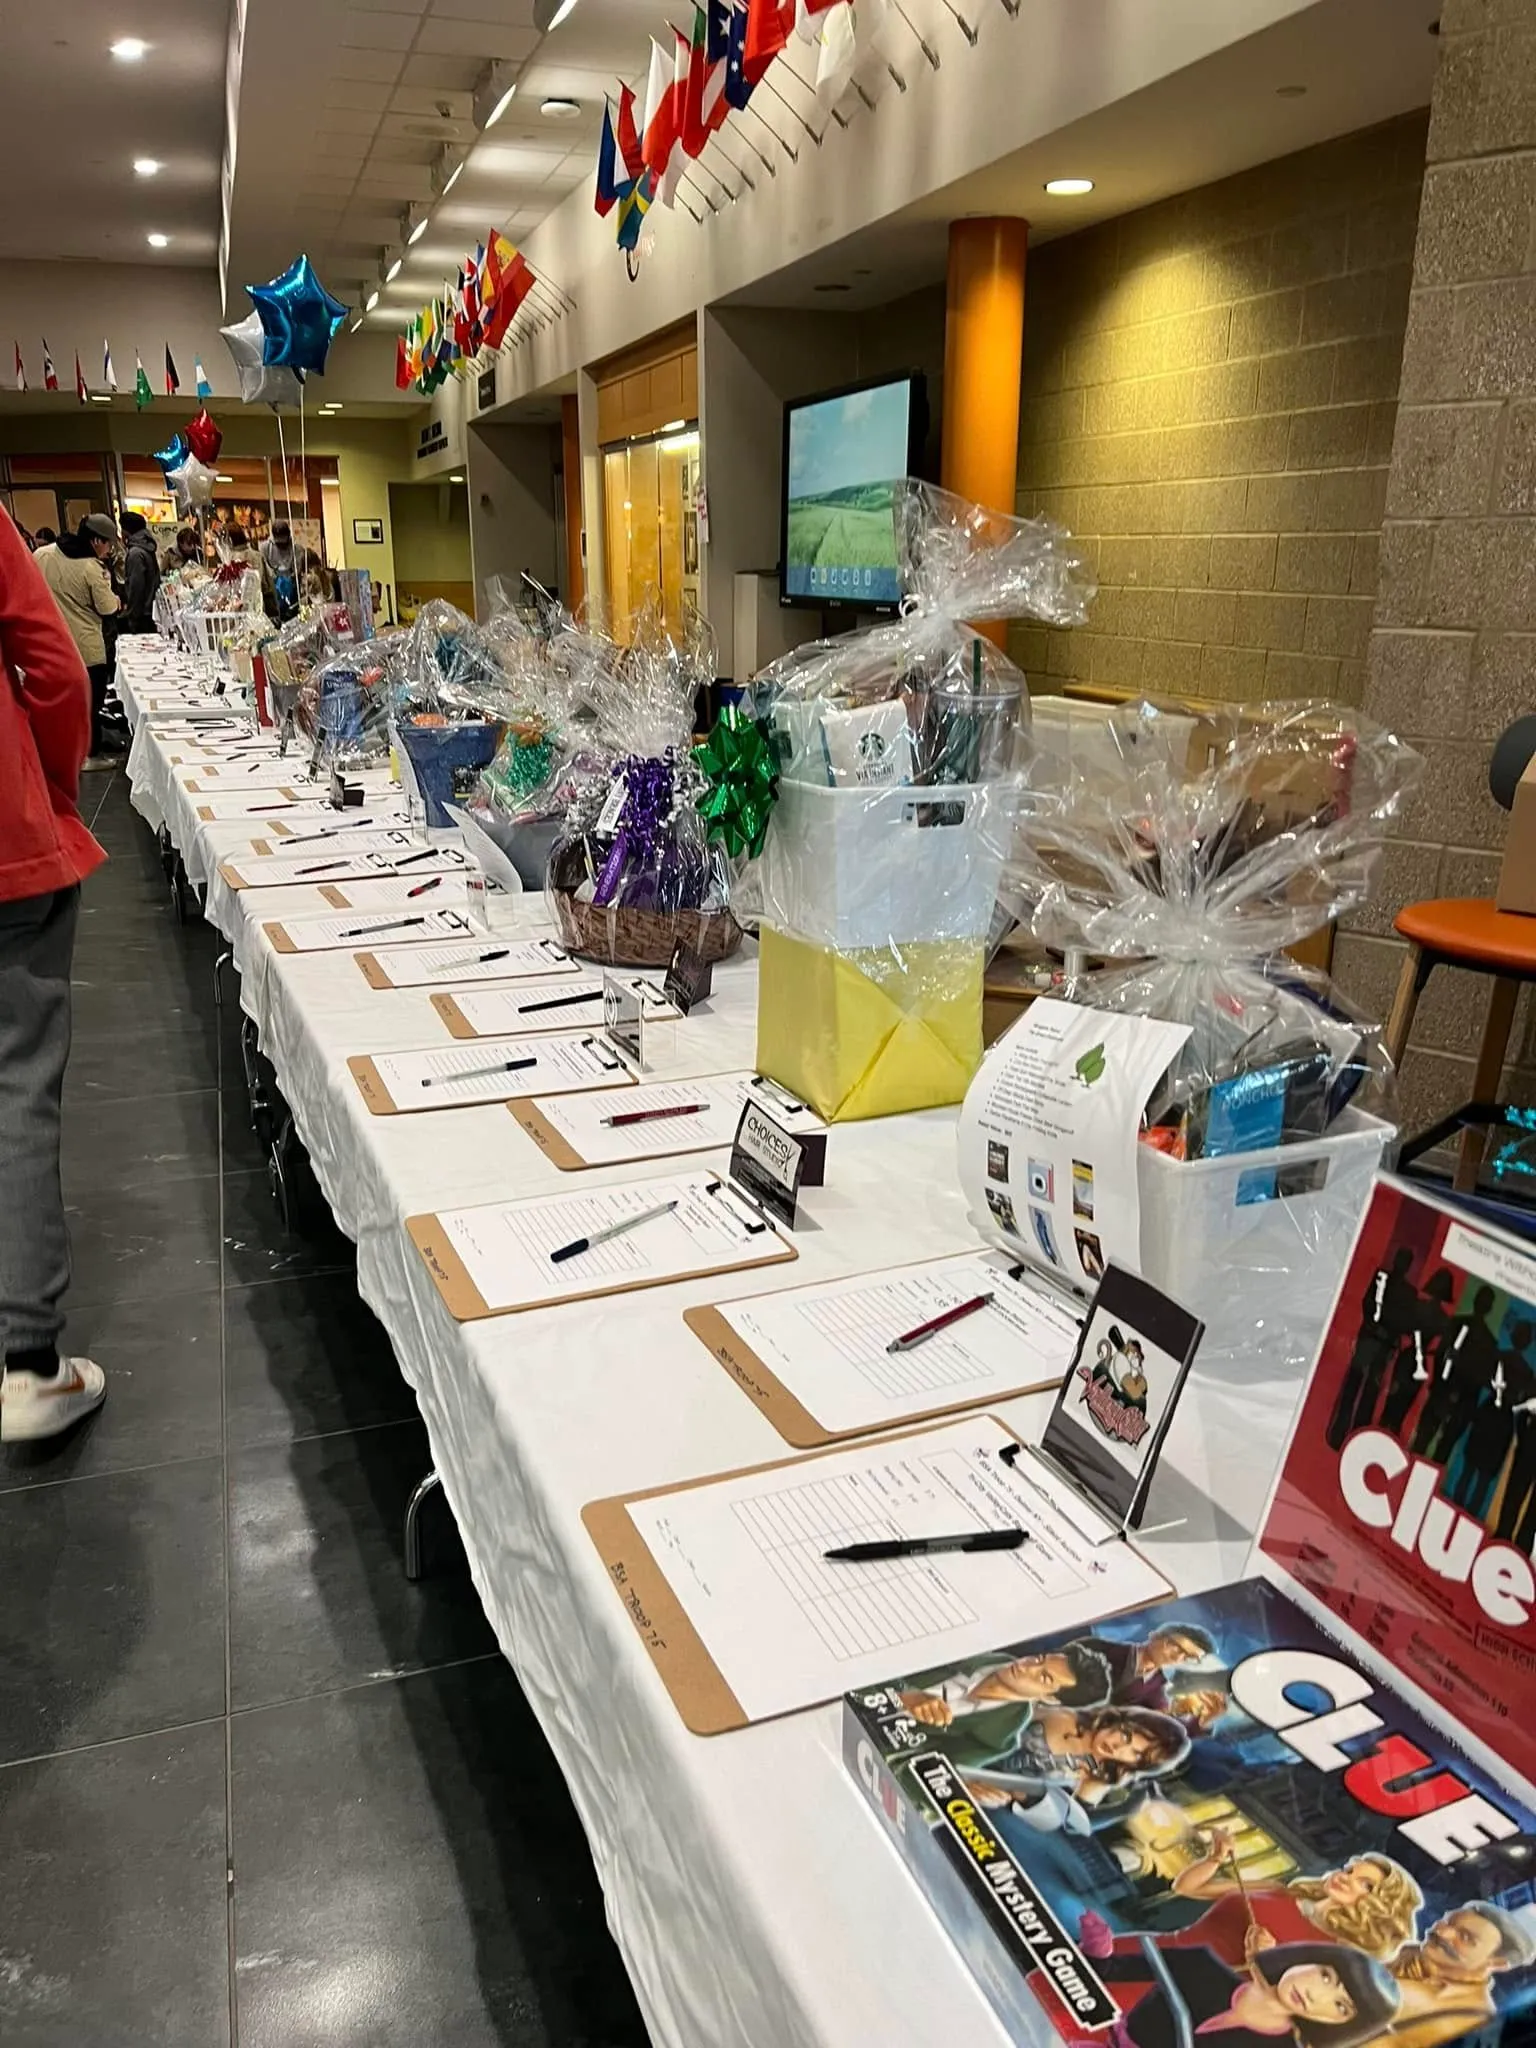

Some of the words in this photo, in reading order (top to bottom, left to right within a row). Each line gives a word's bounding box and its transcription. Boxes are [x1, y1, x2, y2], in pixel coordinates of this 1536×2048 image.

[748, 1117, 788, 1159] CHOICES
[1339, 1430, 1535, 1626] Clue
[1231, 1650, 1519, 1866] CLUE
[923, 1763, 952, 1799] The
[946, 1799, 996, 1861] Classic
[985, 1859, 1053, 1945] Mystery
[1045, 1947, 1097, 2013] Game
